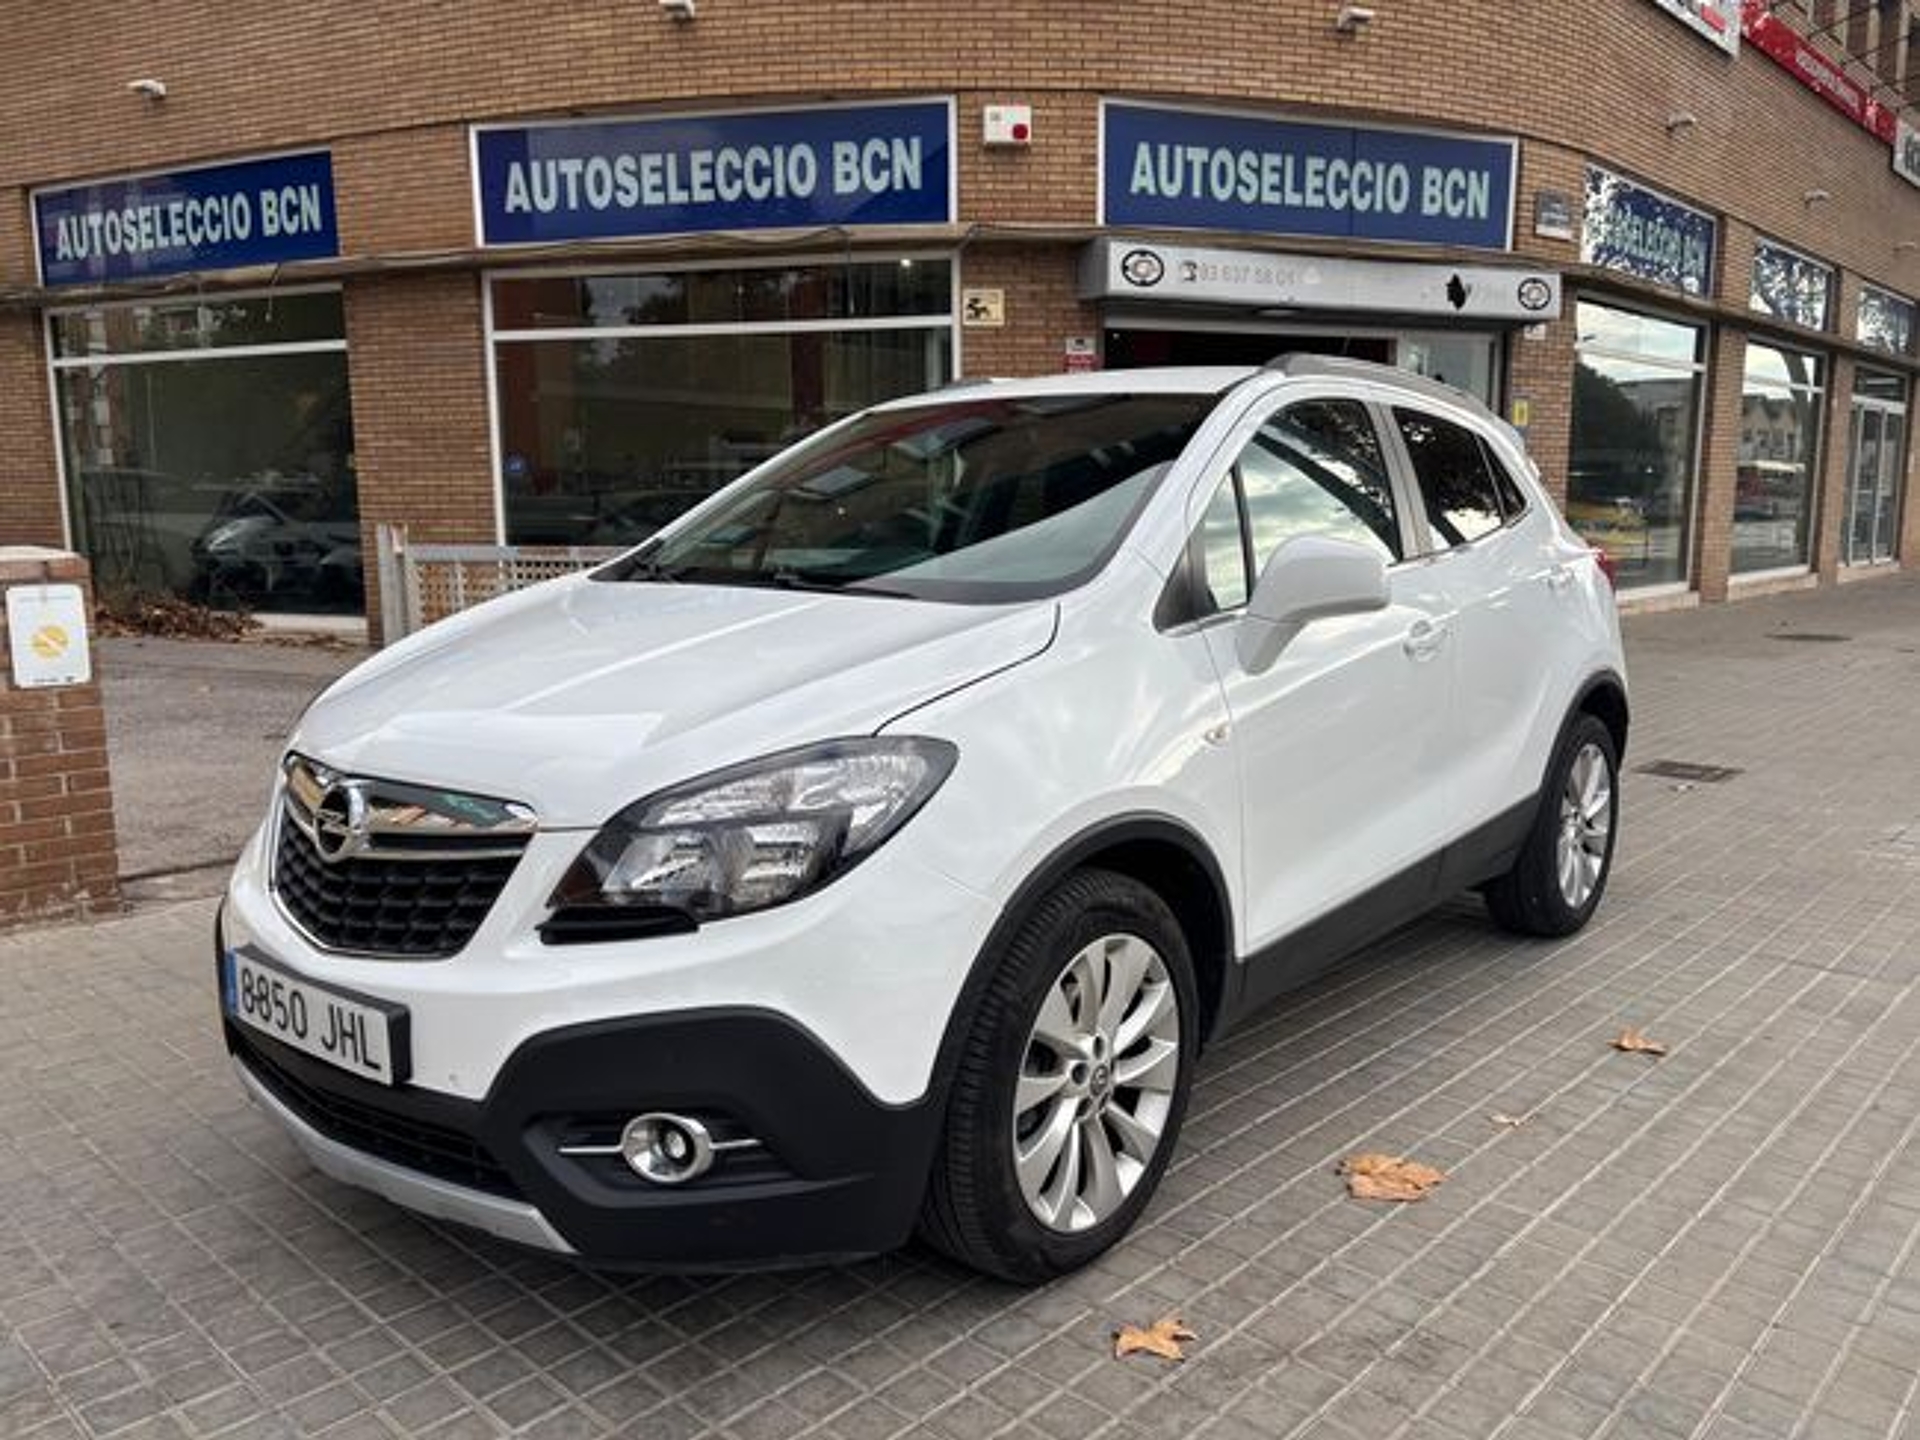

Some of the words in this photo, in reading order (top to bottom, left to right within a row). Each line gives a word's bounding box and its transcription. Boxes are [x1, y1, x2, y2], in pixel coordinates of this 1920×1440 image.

[505, 143, 817, 213] AUTOSELECCIO
[833, 136, 922, 194] BCN
[1130, 142, 1409, 214] AUTOSELECCIO
[1421, 166, 1490, 219] BCN
[57, 192, 251, 260] AUTOSELECCIO
[259, 184, 321, 236] BCN
[242, 968, 308, 1040] 8850
[321, 1002, 381, 1072] JHL
